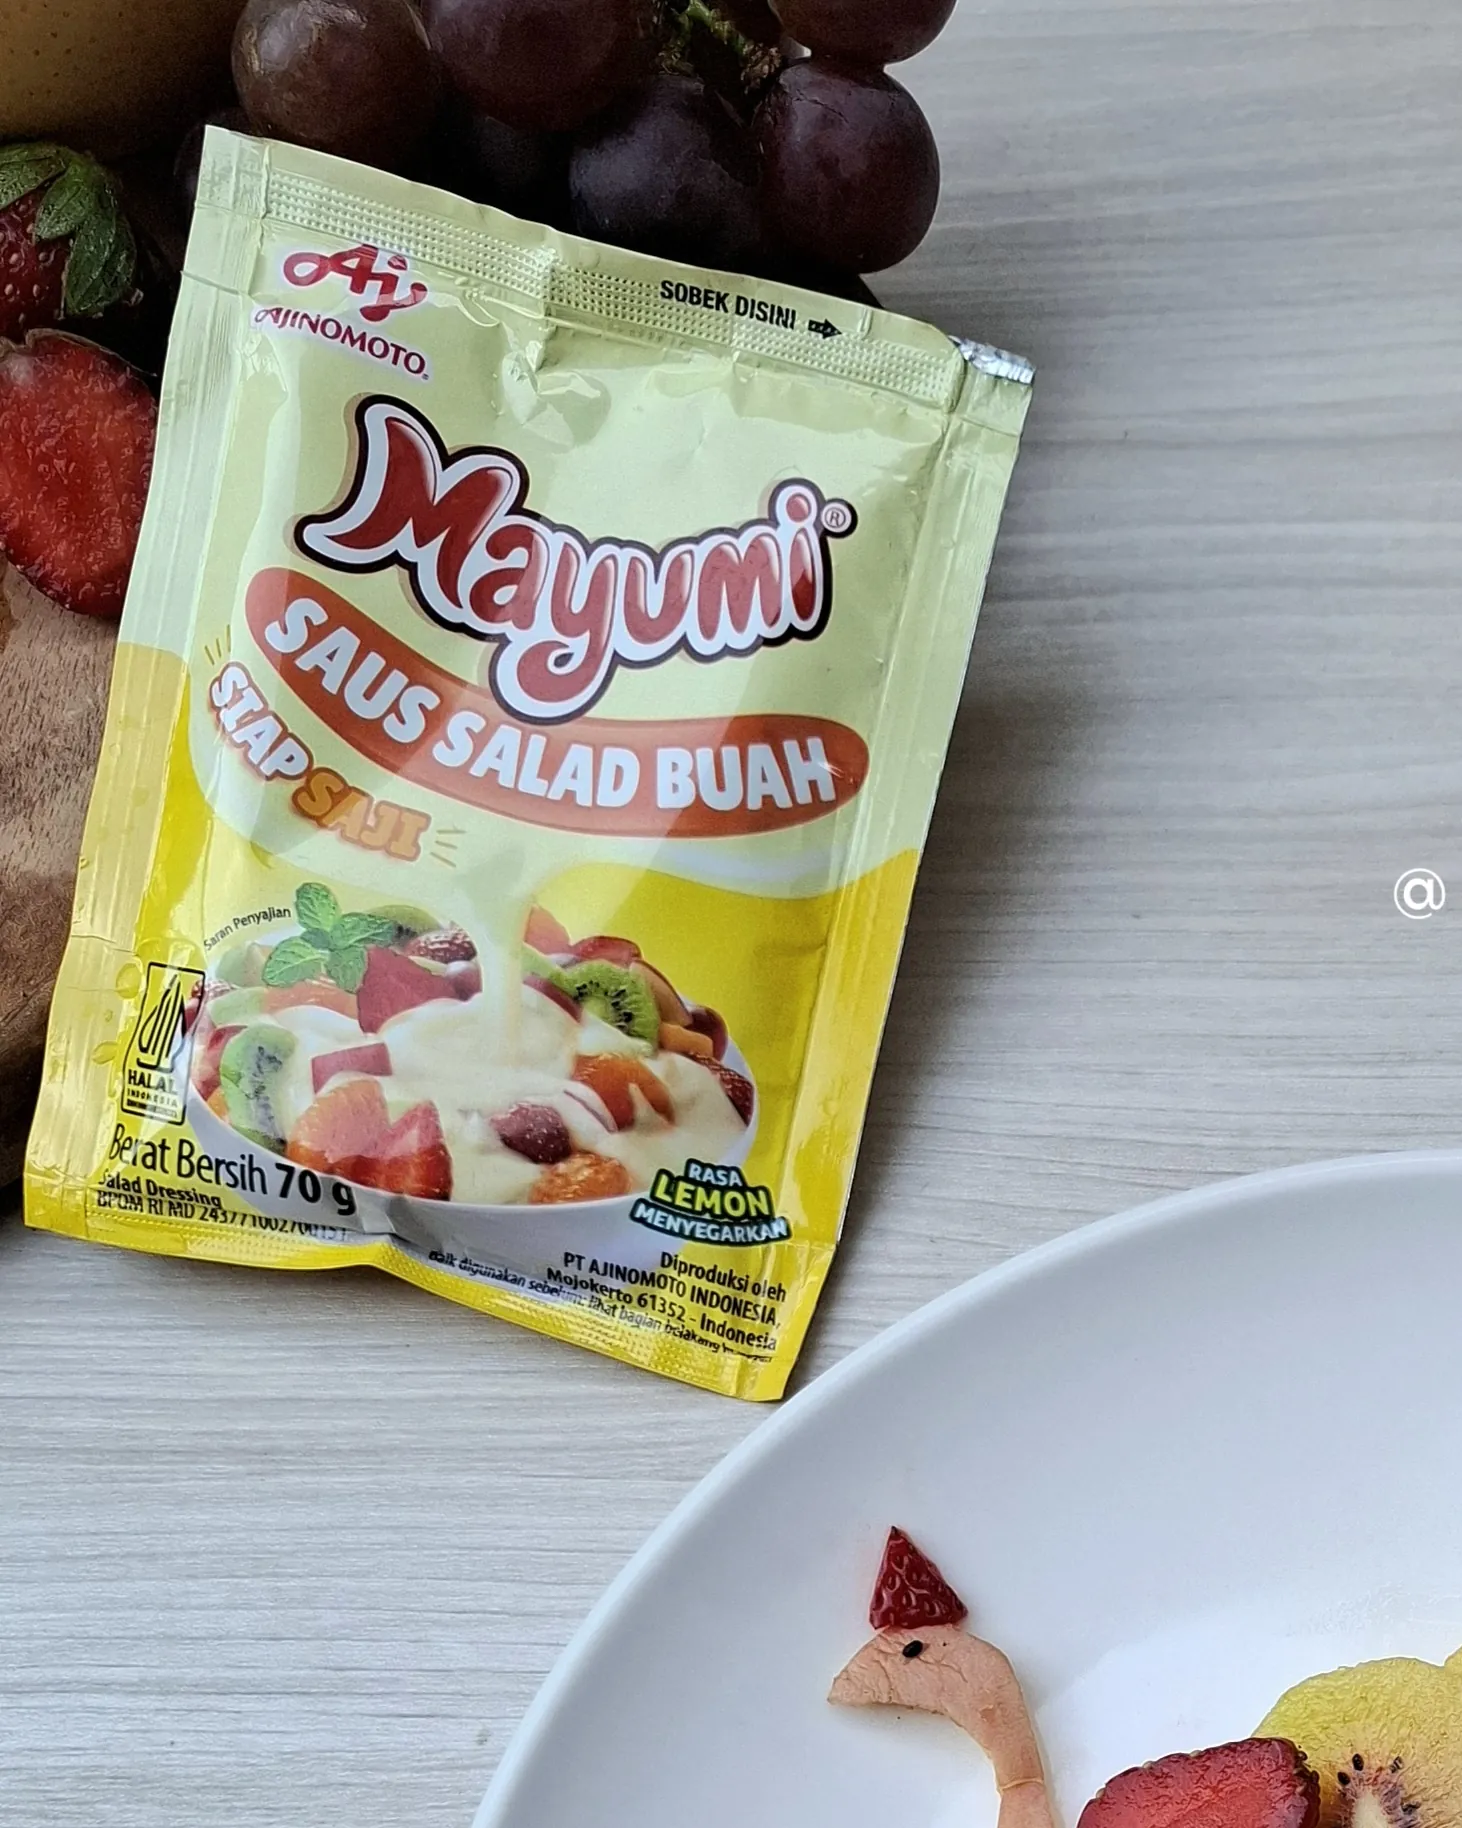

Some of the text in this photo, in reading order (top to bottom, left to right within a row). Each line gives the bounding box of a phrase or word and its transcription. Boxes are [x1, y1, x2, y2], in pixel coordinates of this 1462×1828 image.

[659, 279, 796, 330] SOBEK DISINI
[255, 306, 426, 377] AJINOMOTO
[265, 598, 837, 811] SAUS SALAD BUAH
[211, 664, 431, 859] SIAP SAJI
[203, 906, 292, 951] Saran Penyajian
[128, 1069, 178, 1096] HALAL
[99, 1168, 223, 1210] Salad Dressing
[109, 1123, 356, 1216] Berat Bersih 70 g
[688, 1162, 743, 1188] RASA
[148, 1195, 164, 1215] RI
[168, 1200, 195, 1219] MD
[654, 1173, 771, 1219] LEMON
[634, 1203, 788, 1244] MENYEGARKAN
[563, 1252, 781, 1328] PT AJINOMOTO INDONESIA,
[660, 1251, 787, 1302] Diproduksi oleh
[546, 1267, 633, 1305] Mojokerto
[637, 1292, 687, 1323] 61352
[700, 1312, 777, 1351] Indonesia
